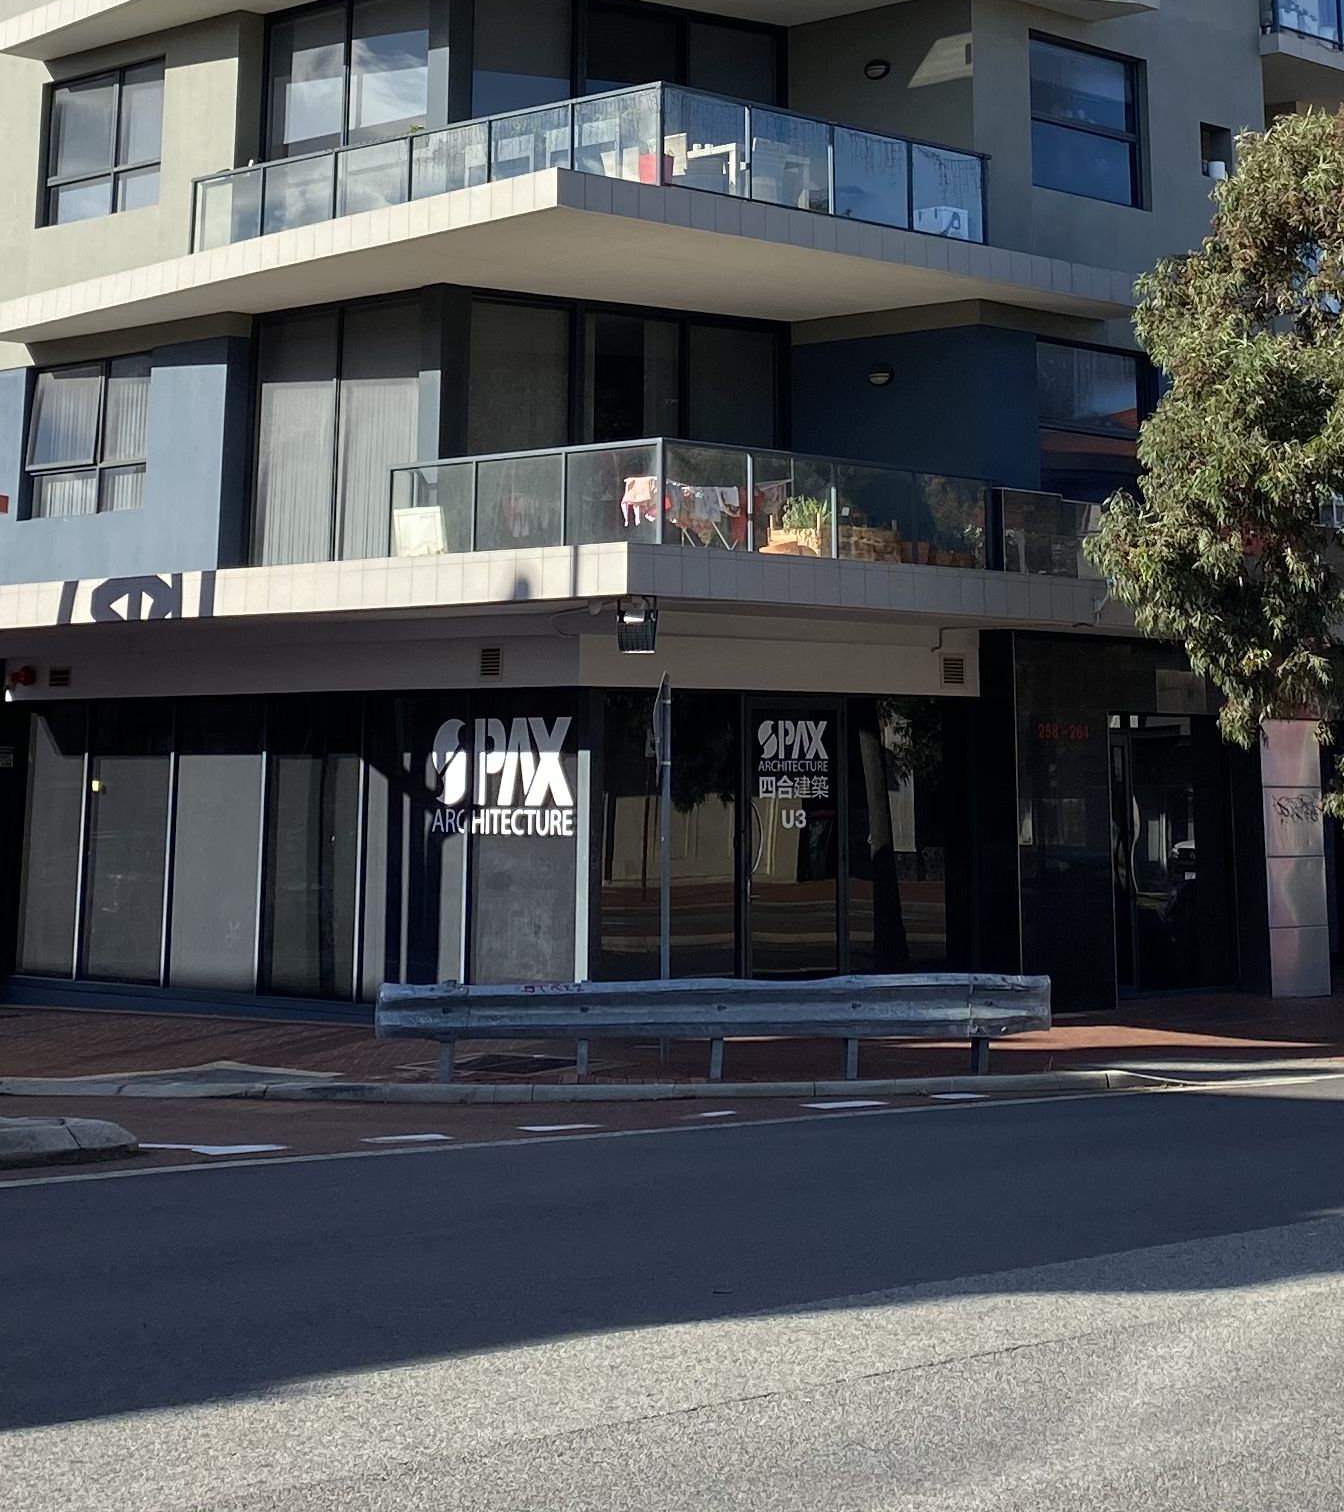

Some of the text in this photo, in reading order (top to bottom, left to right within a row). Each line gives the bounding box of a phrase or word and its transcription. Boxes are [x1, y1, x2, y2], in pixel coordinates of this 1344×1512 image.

[757, 719, 829, 760] SPAX
[431, 716, 574, 808] SPAX
[758, 760, 829, 773] ARCHITECTURE
[759, 775, 829, 799] 四合建築
[431, 808, 574, 836] ARCHITECTURE
[781, 809, 807, 829] U3
